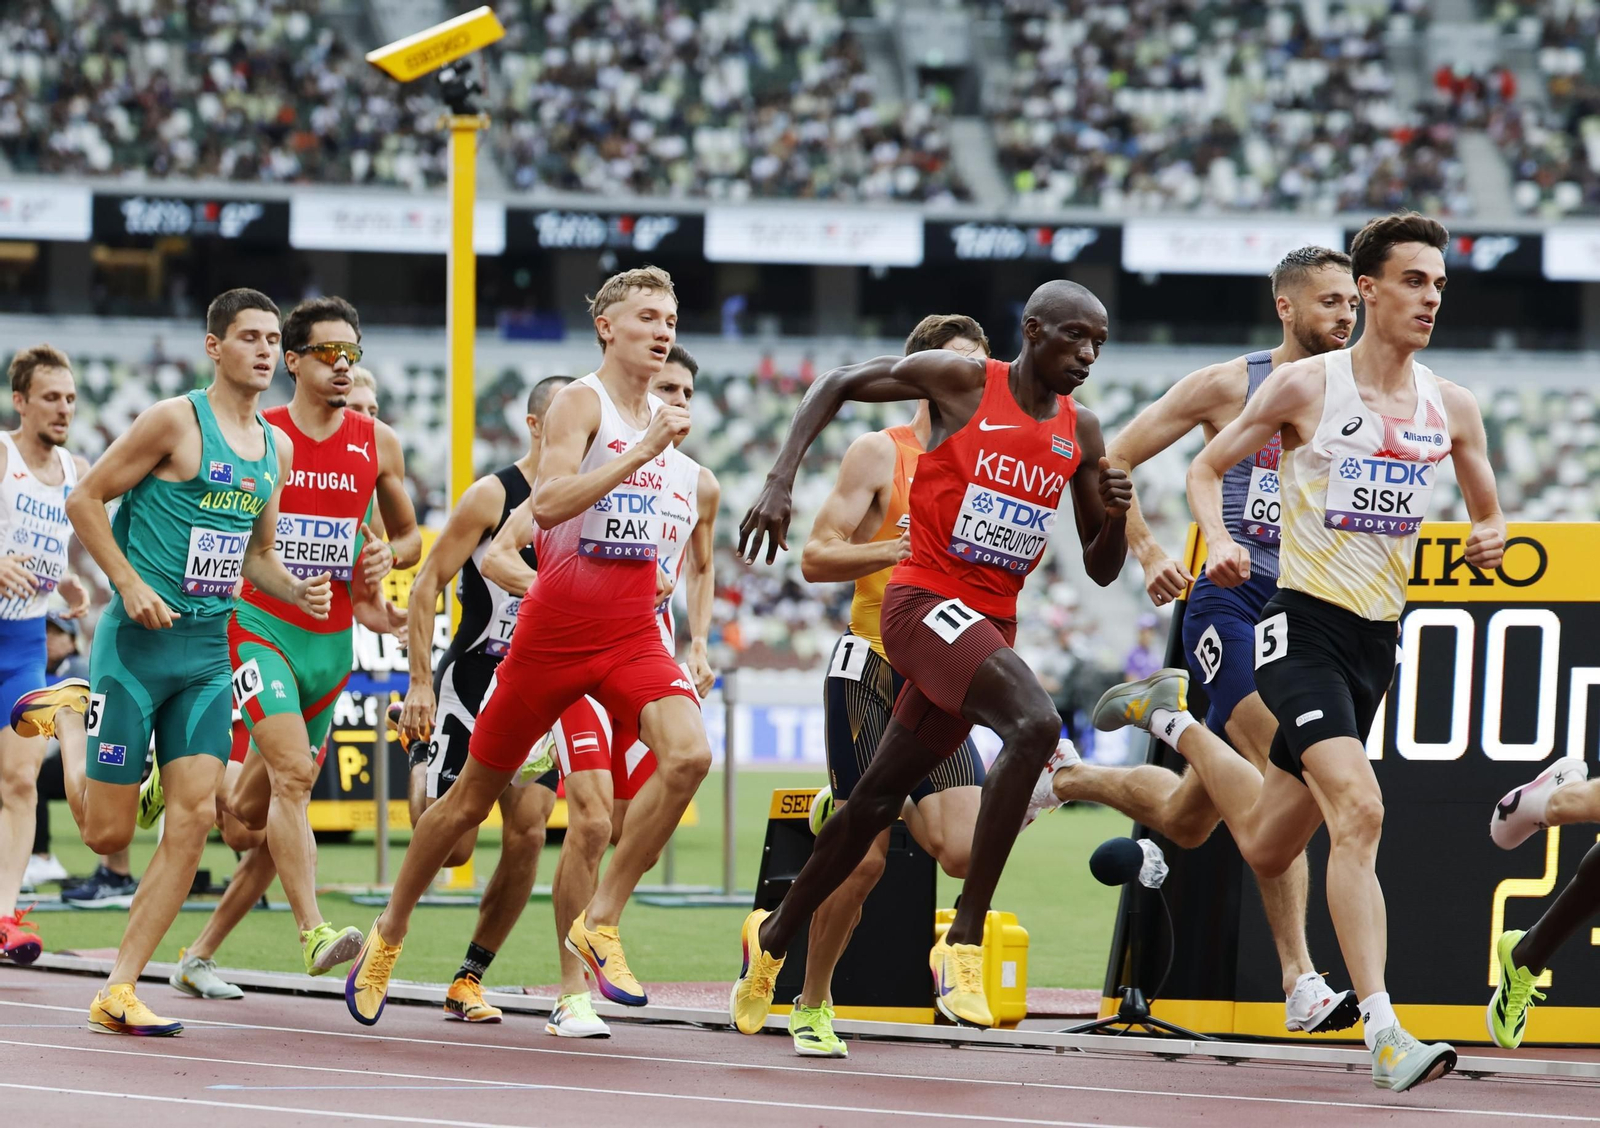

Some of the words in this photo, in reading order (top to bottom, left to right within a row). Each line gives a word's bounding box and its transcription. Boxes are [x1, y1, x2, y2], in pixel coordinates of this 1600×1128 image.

[1403, 431, 1432, 443] Allianz
[974, 448, 1064, 499] KENYA
[1362, 458, 1430, 487] TDK
[16, 493, 69, 526] CZECHIA
[612, 492, 658, 515] TDK
[1351, 487, 1414, 515] SISK
[996, 497, 1053, 532] TDK
[1354, 517, 1408, 532] TOKYO
[294, 518, 351, 540] TDK
[605, 518, 650, 541] RAK
[958, 514, 973, 538] T.
[973, 520, 1045, 557] CHERUIYOT
[30, 531, 66, 556] TDK
[216, 534, 249, 555] TDK
[275, 540, 349, 563] PEREIRA
[605, 546, 651, 558] TOKYO
[975, 551, 1017, 571] TOKYO
[934, 603, 973, 631] 11
[1262, 623, 1278, 658] 5
[840, 642, 855, 671] 1
[1200, 637, 1221, 675] 13
[233, 667, 259, 701] 10
[780, 794, 816, 814] SEI
